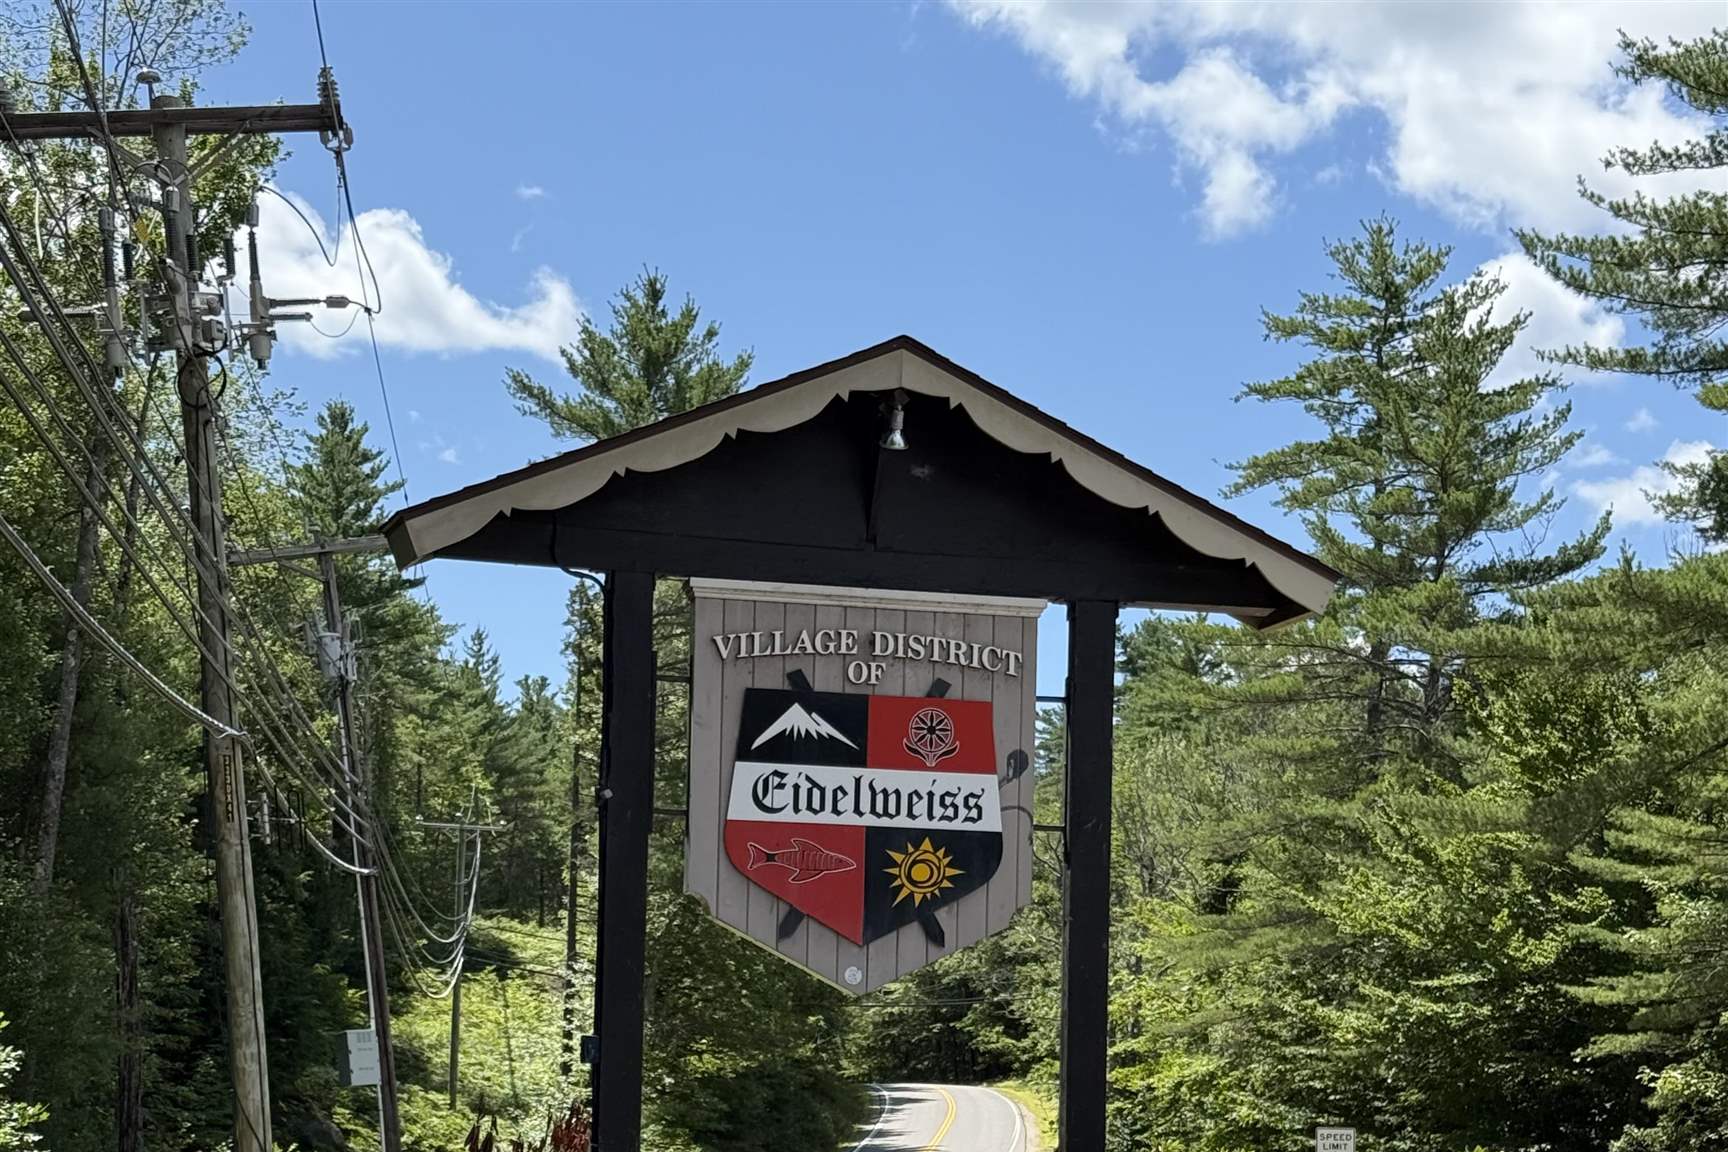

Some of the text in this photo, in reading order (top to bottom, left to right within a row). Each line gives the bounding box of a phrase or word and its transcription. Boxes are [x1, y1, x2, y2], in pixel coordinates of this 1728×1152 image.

[712, 629, 1023, 677] VILLAGE DISTRICT
[847, 660, 887, 685] OF
[751, 769, 985, 825] Eidelweiss
[1319, 1133, 1352, 1141] SPEED
